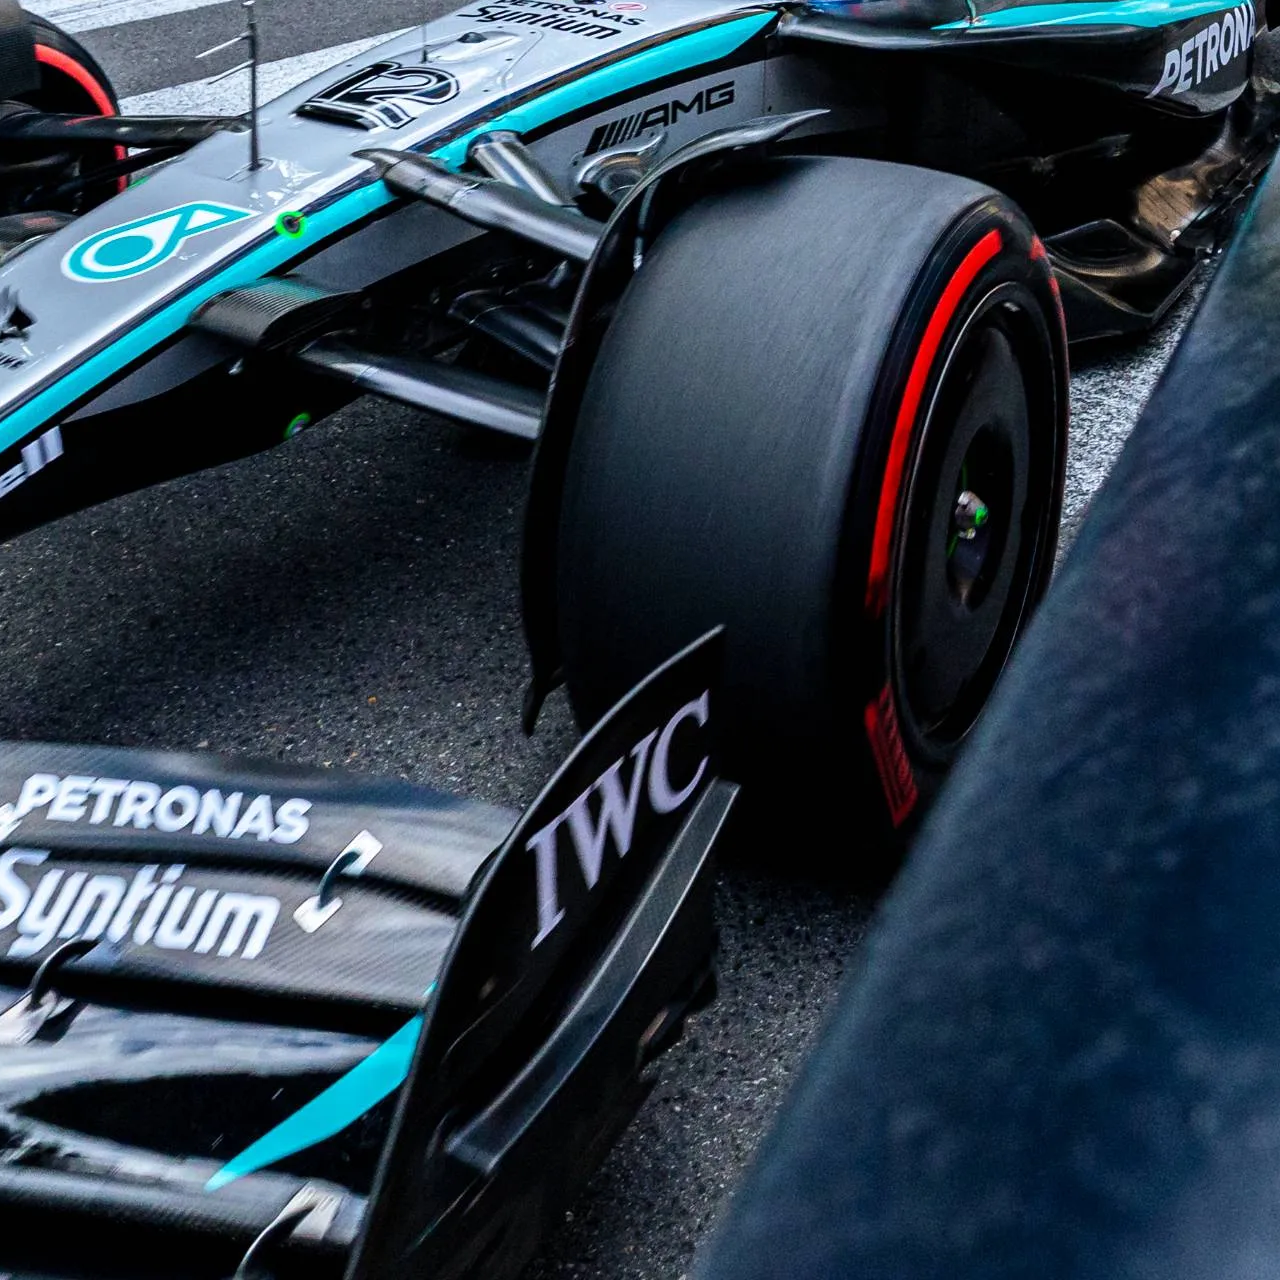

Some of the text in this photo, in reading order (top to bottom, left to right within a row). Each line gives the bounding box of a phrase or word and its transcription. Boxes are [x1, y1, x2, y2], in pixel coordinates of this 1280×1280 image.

[457, 5, 622, 40] Syntium
[290, 60, 462, 132] 12
[640, 80, 736, 135] AMG
[16, 773, 313, 845] PETRONAS
[525, 689, 710, 951] IWC
